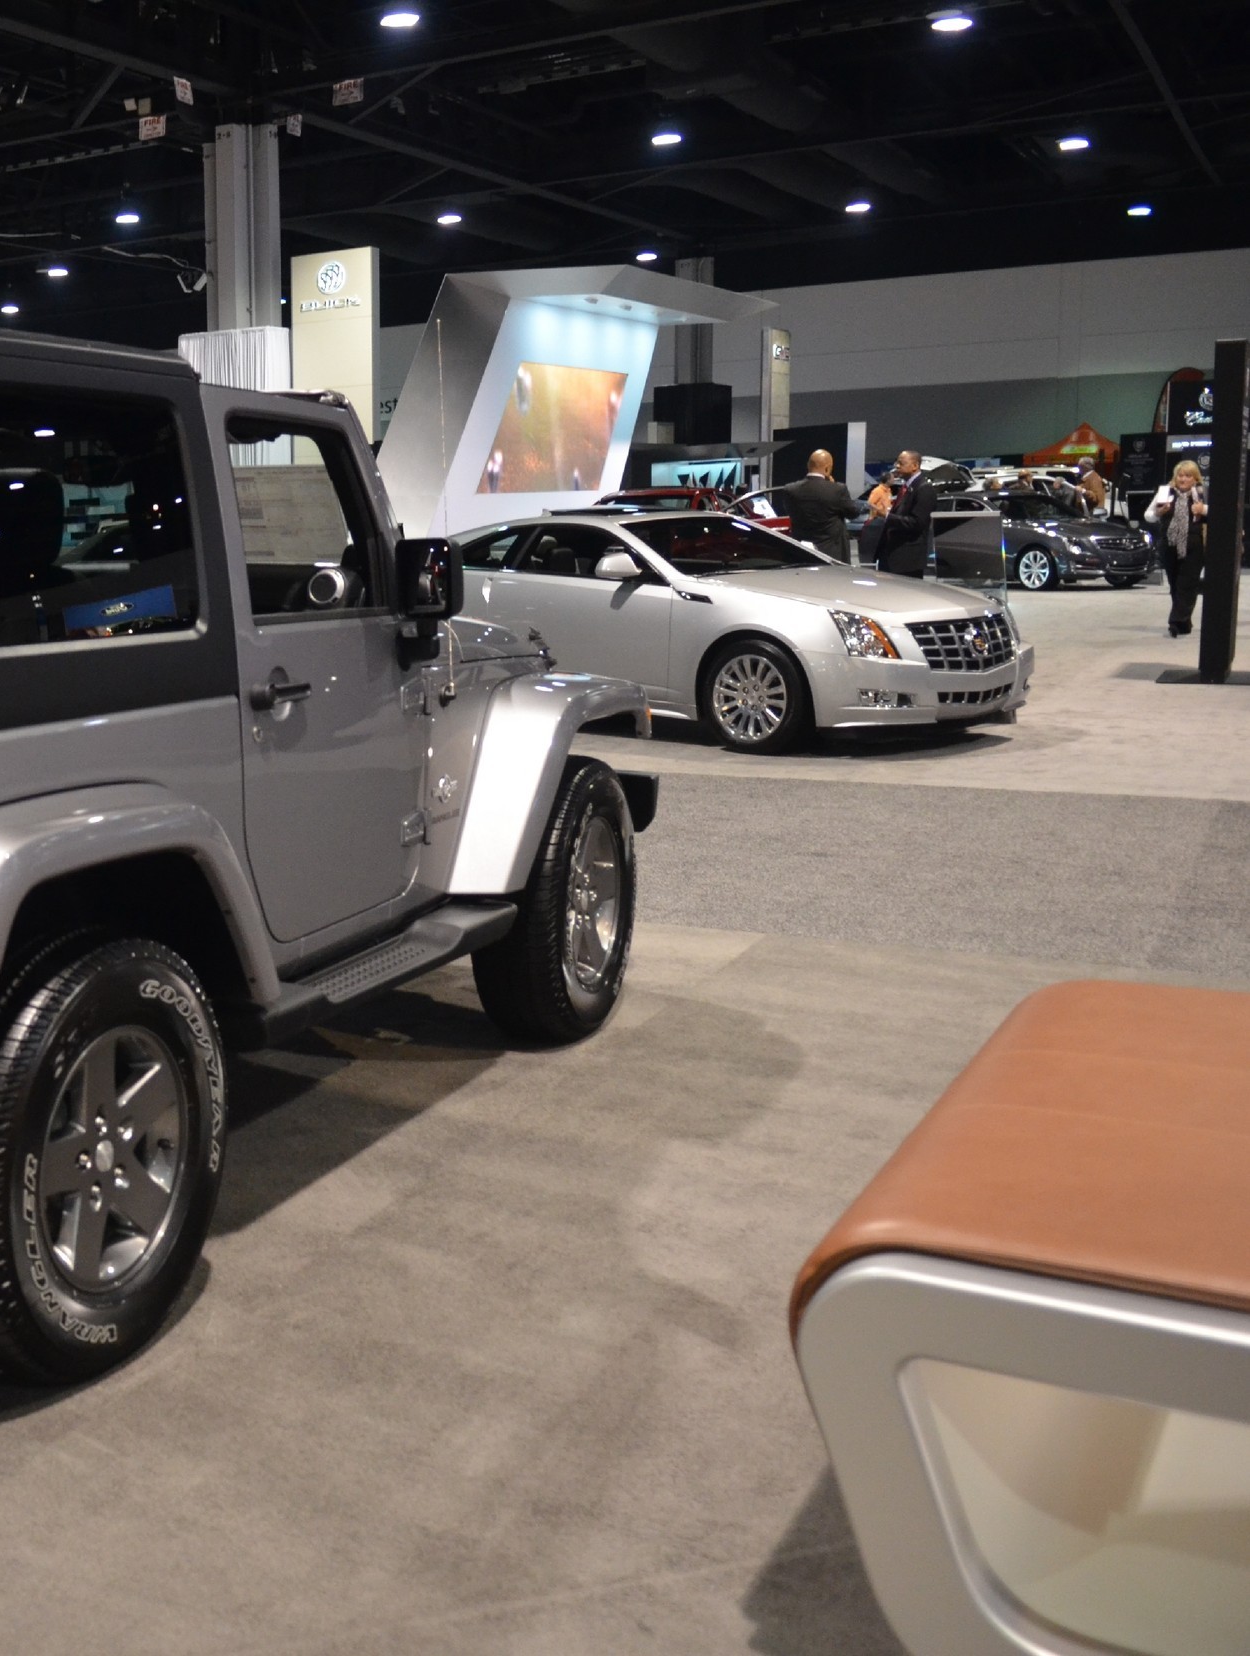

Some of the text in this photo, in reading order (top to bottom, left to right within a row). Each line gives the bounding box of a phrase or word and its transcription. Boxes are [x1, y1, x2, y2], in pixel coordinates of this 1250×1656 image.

[338, 80, 358, 92] FIRE
[143, 116, 161, 127] FIRE
[299, 297, 362, 313] BUICK
[138, 979, 222, 1173] GOODYEAR
[22, 1153, 118, 1344] WRANGLER
